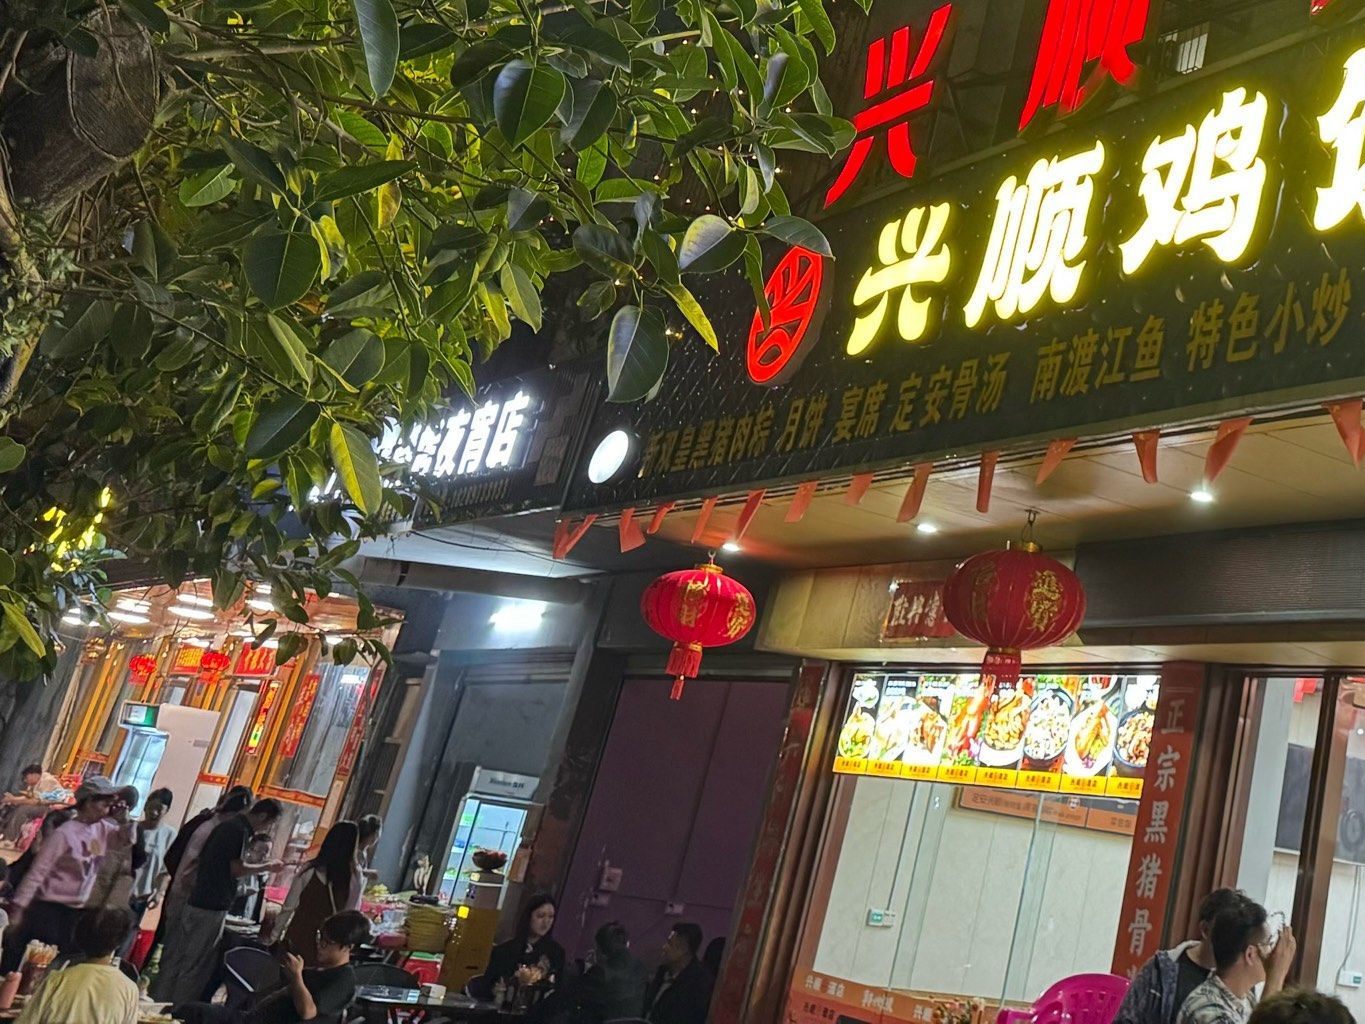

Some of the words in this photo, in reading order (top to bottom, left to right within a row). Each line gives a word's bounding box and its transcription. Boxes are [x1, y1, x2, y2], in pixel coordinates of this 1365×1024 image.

[775, 391, 829, 453] 月饼
[832, 379, 889, 443] 宴席
[889, 351, 1012, 432] 定安骨汤
[1030, 315, 1165, 403] 南渡江鱼
[1186, 267, 1351, 373] 特色小炒
[1125, 698, 1181, 979] 正宗黑猪骨
